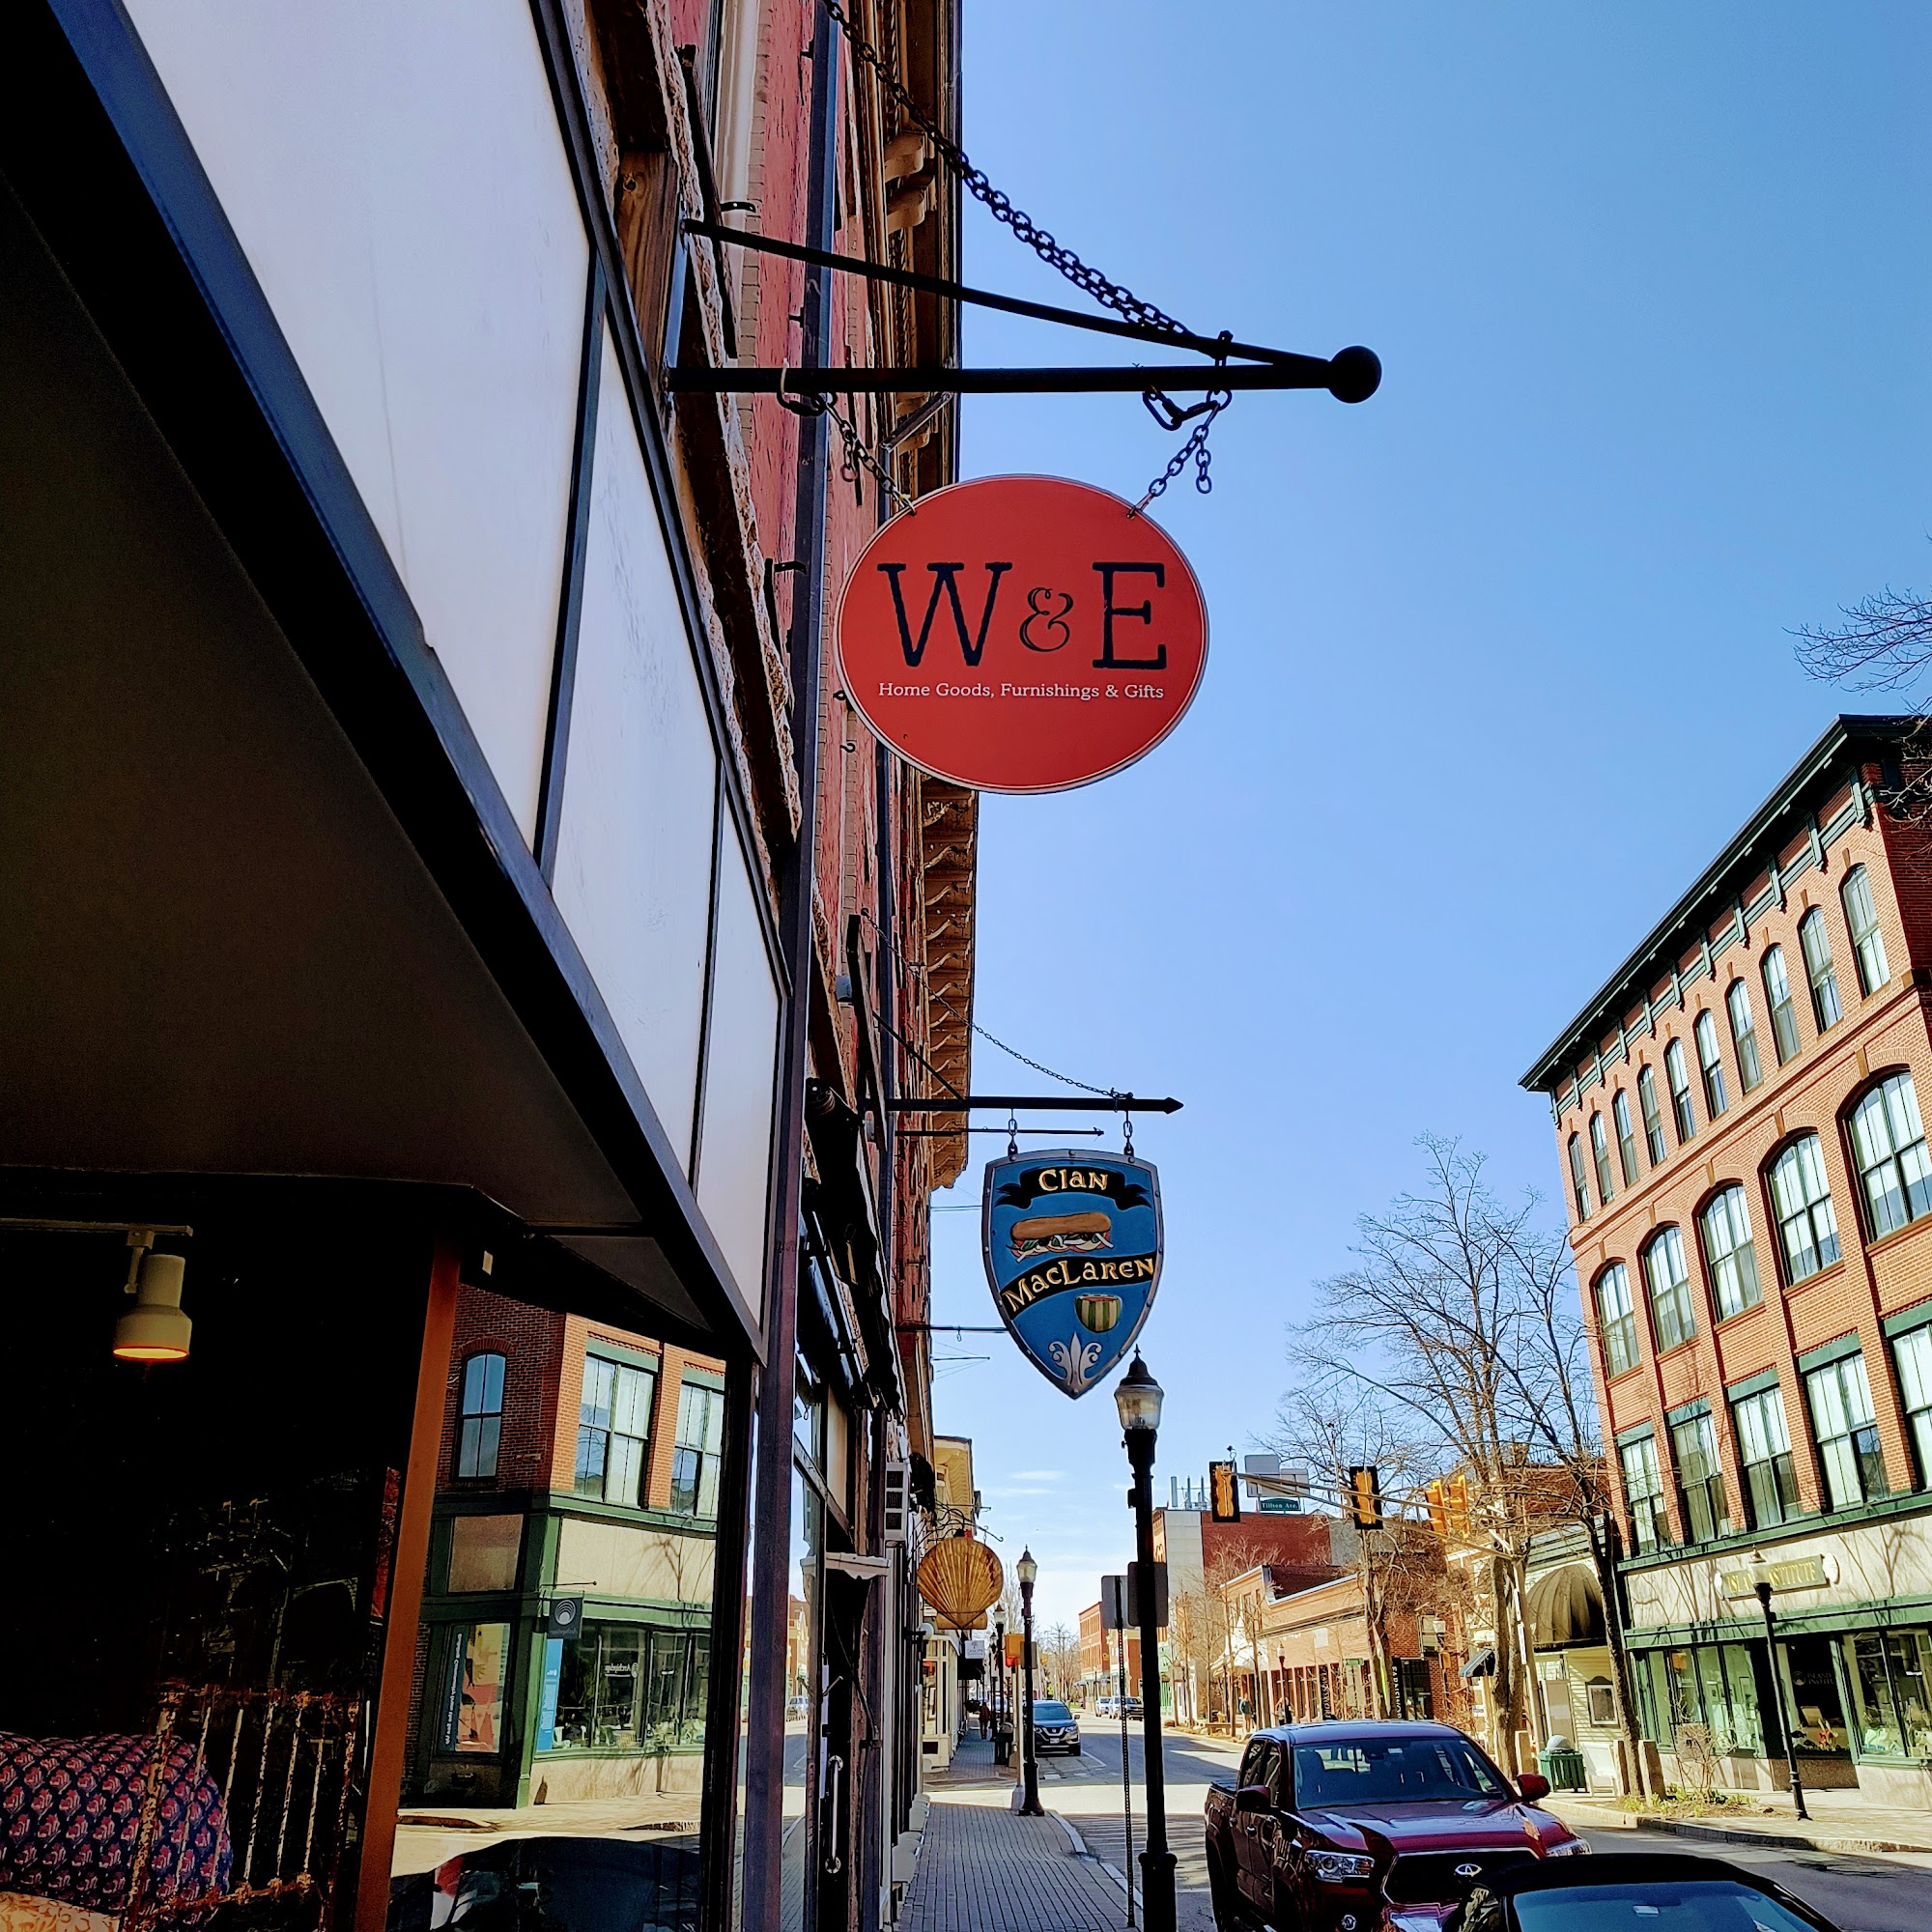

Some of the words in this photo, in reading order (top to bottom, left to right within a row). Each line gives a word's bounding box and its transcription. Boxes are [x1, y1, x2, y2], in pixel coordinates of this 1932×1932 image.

[877, 562, 1012, 667] W
[1019, 586, 1073, 652] &
[1093, 561, 1167, 669] E
[878, 682, 930, 696] Home
[935, 682, 995, 698] Goods,
[1000, 683, 1100, 701] Furnishings
[1104, 684, 1120, 698] &
[1124, 684, 1164, 698] Gifts
[1038, 1168, 1109, 1191] Clan
[1002, 1258, 1155, 1313] MacLaren
[1726, 1573, 1755, 1593] ISLA
[1768, 1561, 1818, 1587] NSTITUTE
[1392, 1666, 1402, 1719] FARNSWOR
